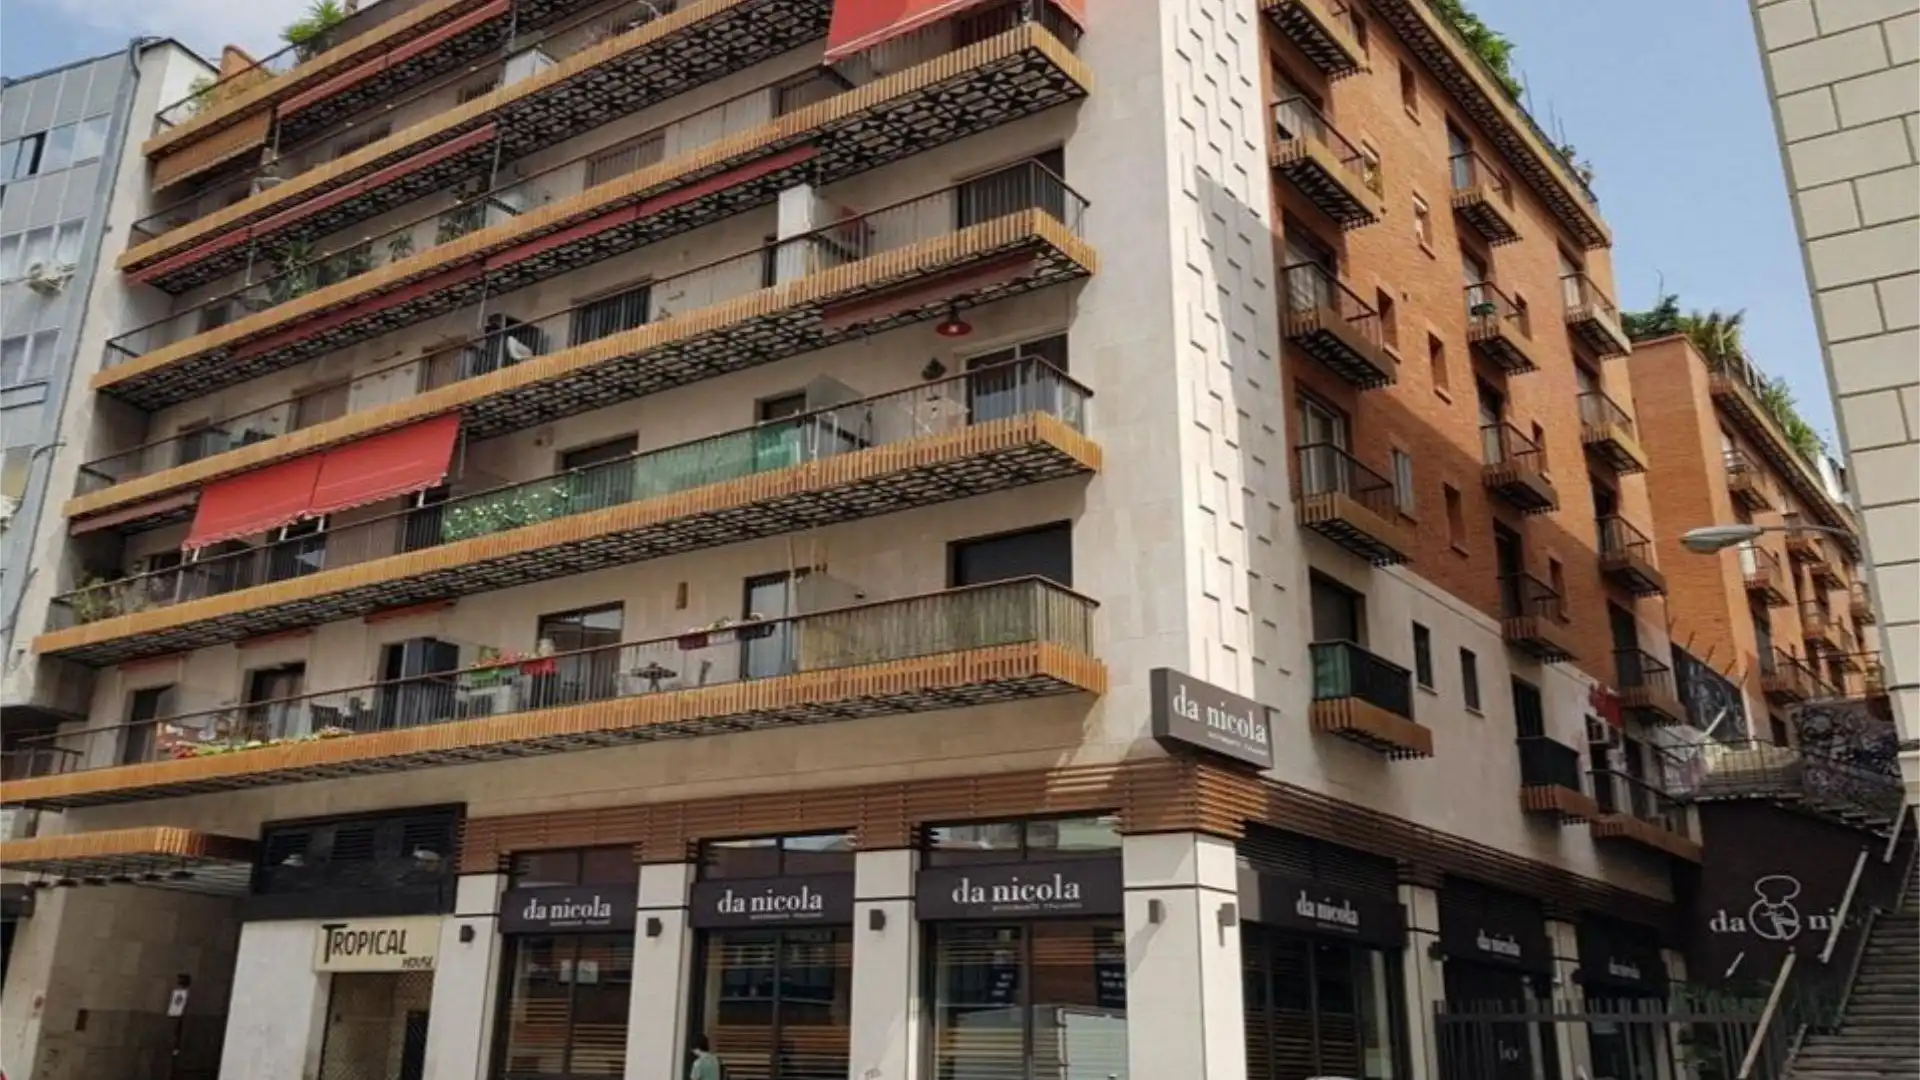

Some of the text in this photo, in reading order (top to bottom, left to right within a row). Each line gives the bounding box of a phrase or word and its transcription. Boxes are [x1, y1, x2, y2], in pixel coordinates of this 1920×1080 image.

[1173, 684, 1199, 721] da
[1207, 701, 1267, 744] nicola
[717, 885, 822, 913] da nicola
[952, 873, 1080, 903] da nicola
[523, 895, 612, 920] da nicola
[1296, 890, 1359, 926] da nicola
[1709, 909, 1746, 932] da
[321, 923, 407, 964] TROPICAL
